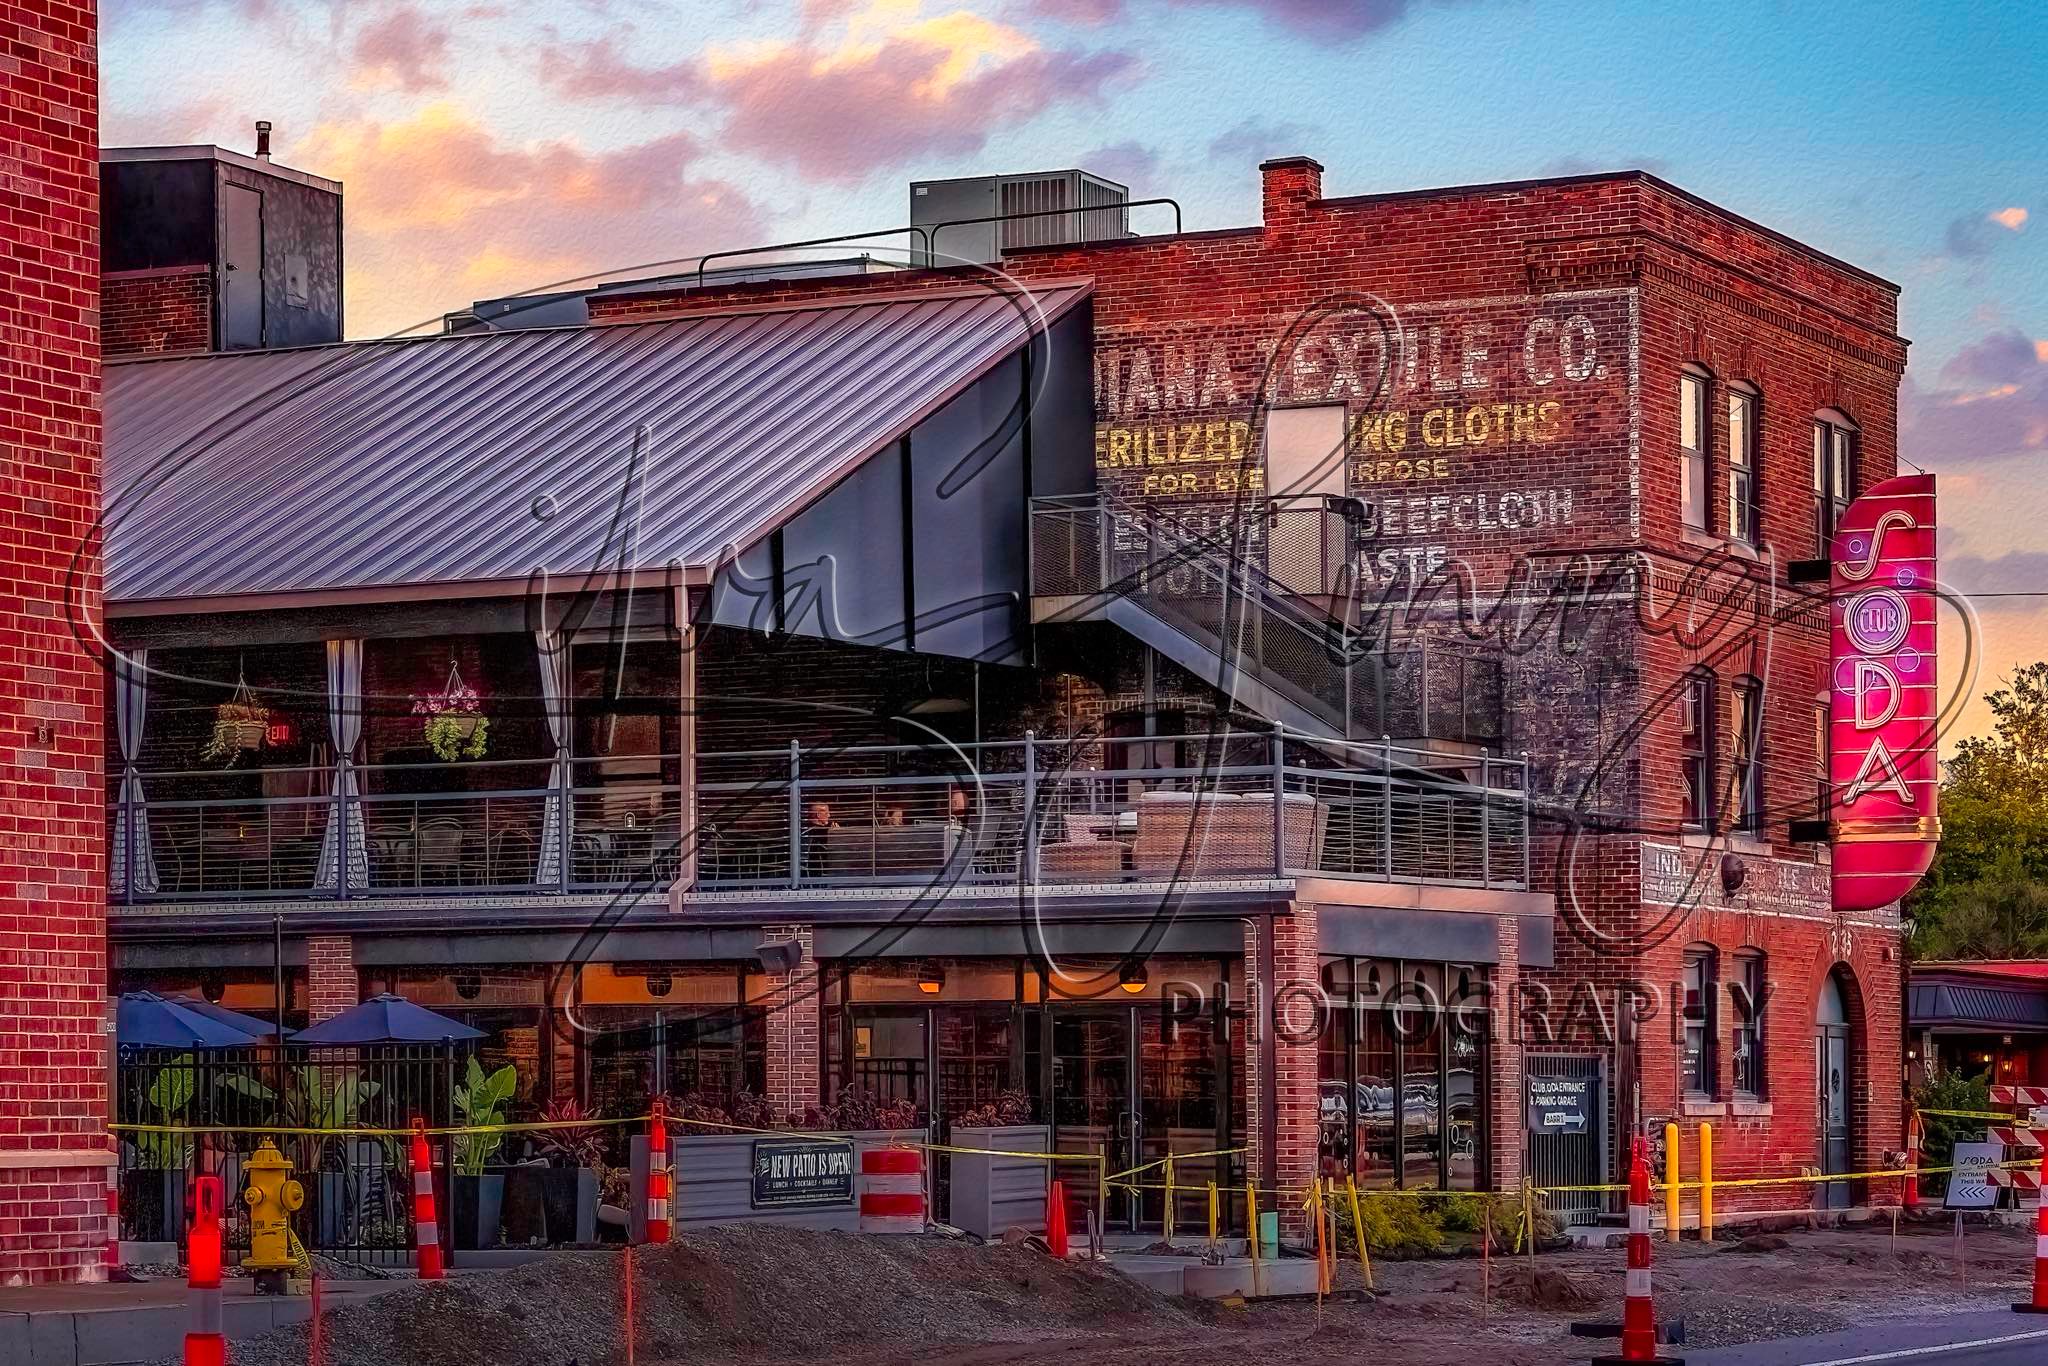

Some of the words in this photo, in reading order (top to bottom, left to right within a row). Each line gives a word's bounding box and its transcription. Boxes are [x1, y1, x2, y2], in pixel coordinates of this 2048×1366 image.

[1523, 314, 1609, 386] CO.
[1144, 473, 1199, 495] FOR
[1350, 457, 1450, 482] RPOSE
[1860, 608, 1897, 633] CLUB
[1531, 1082, 1546, 1093] CLUB
[1559, 1082, 1586, 1093] ENTRANCE
[1535, 1096, 1557, 1106] PARKING
[771, 1155, 791, 1178] NEW
[793, 1154, 815, 1177] PATIO
[819, 1153, 827, 1175] IS
[829, 1152, 851, 1174] OPEN!
[1960, 1157, 1993, 1165] SODA
